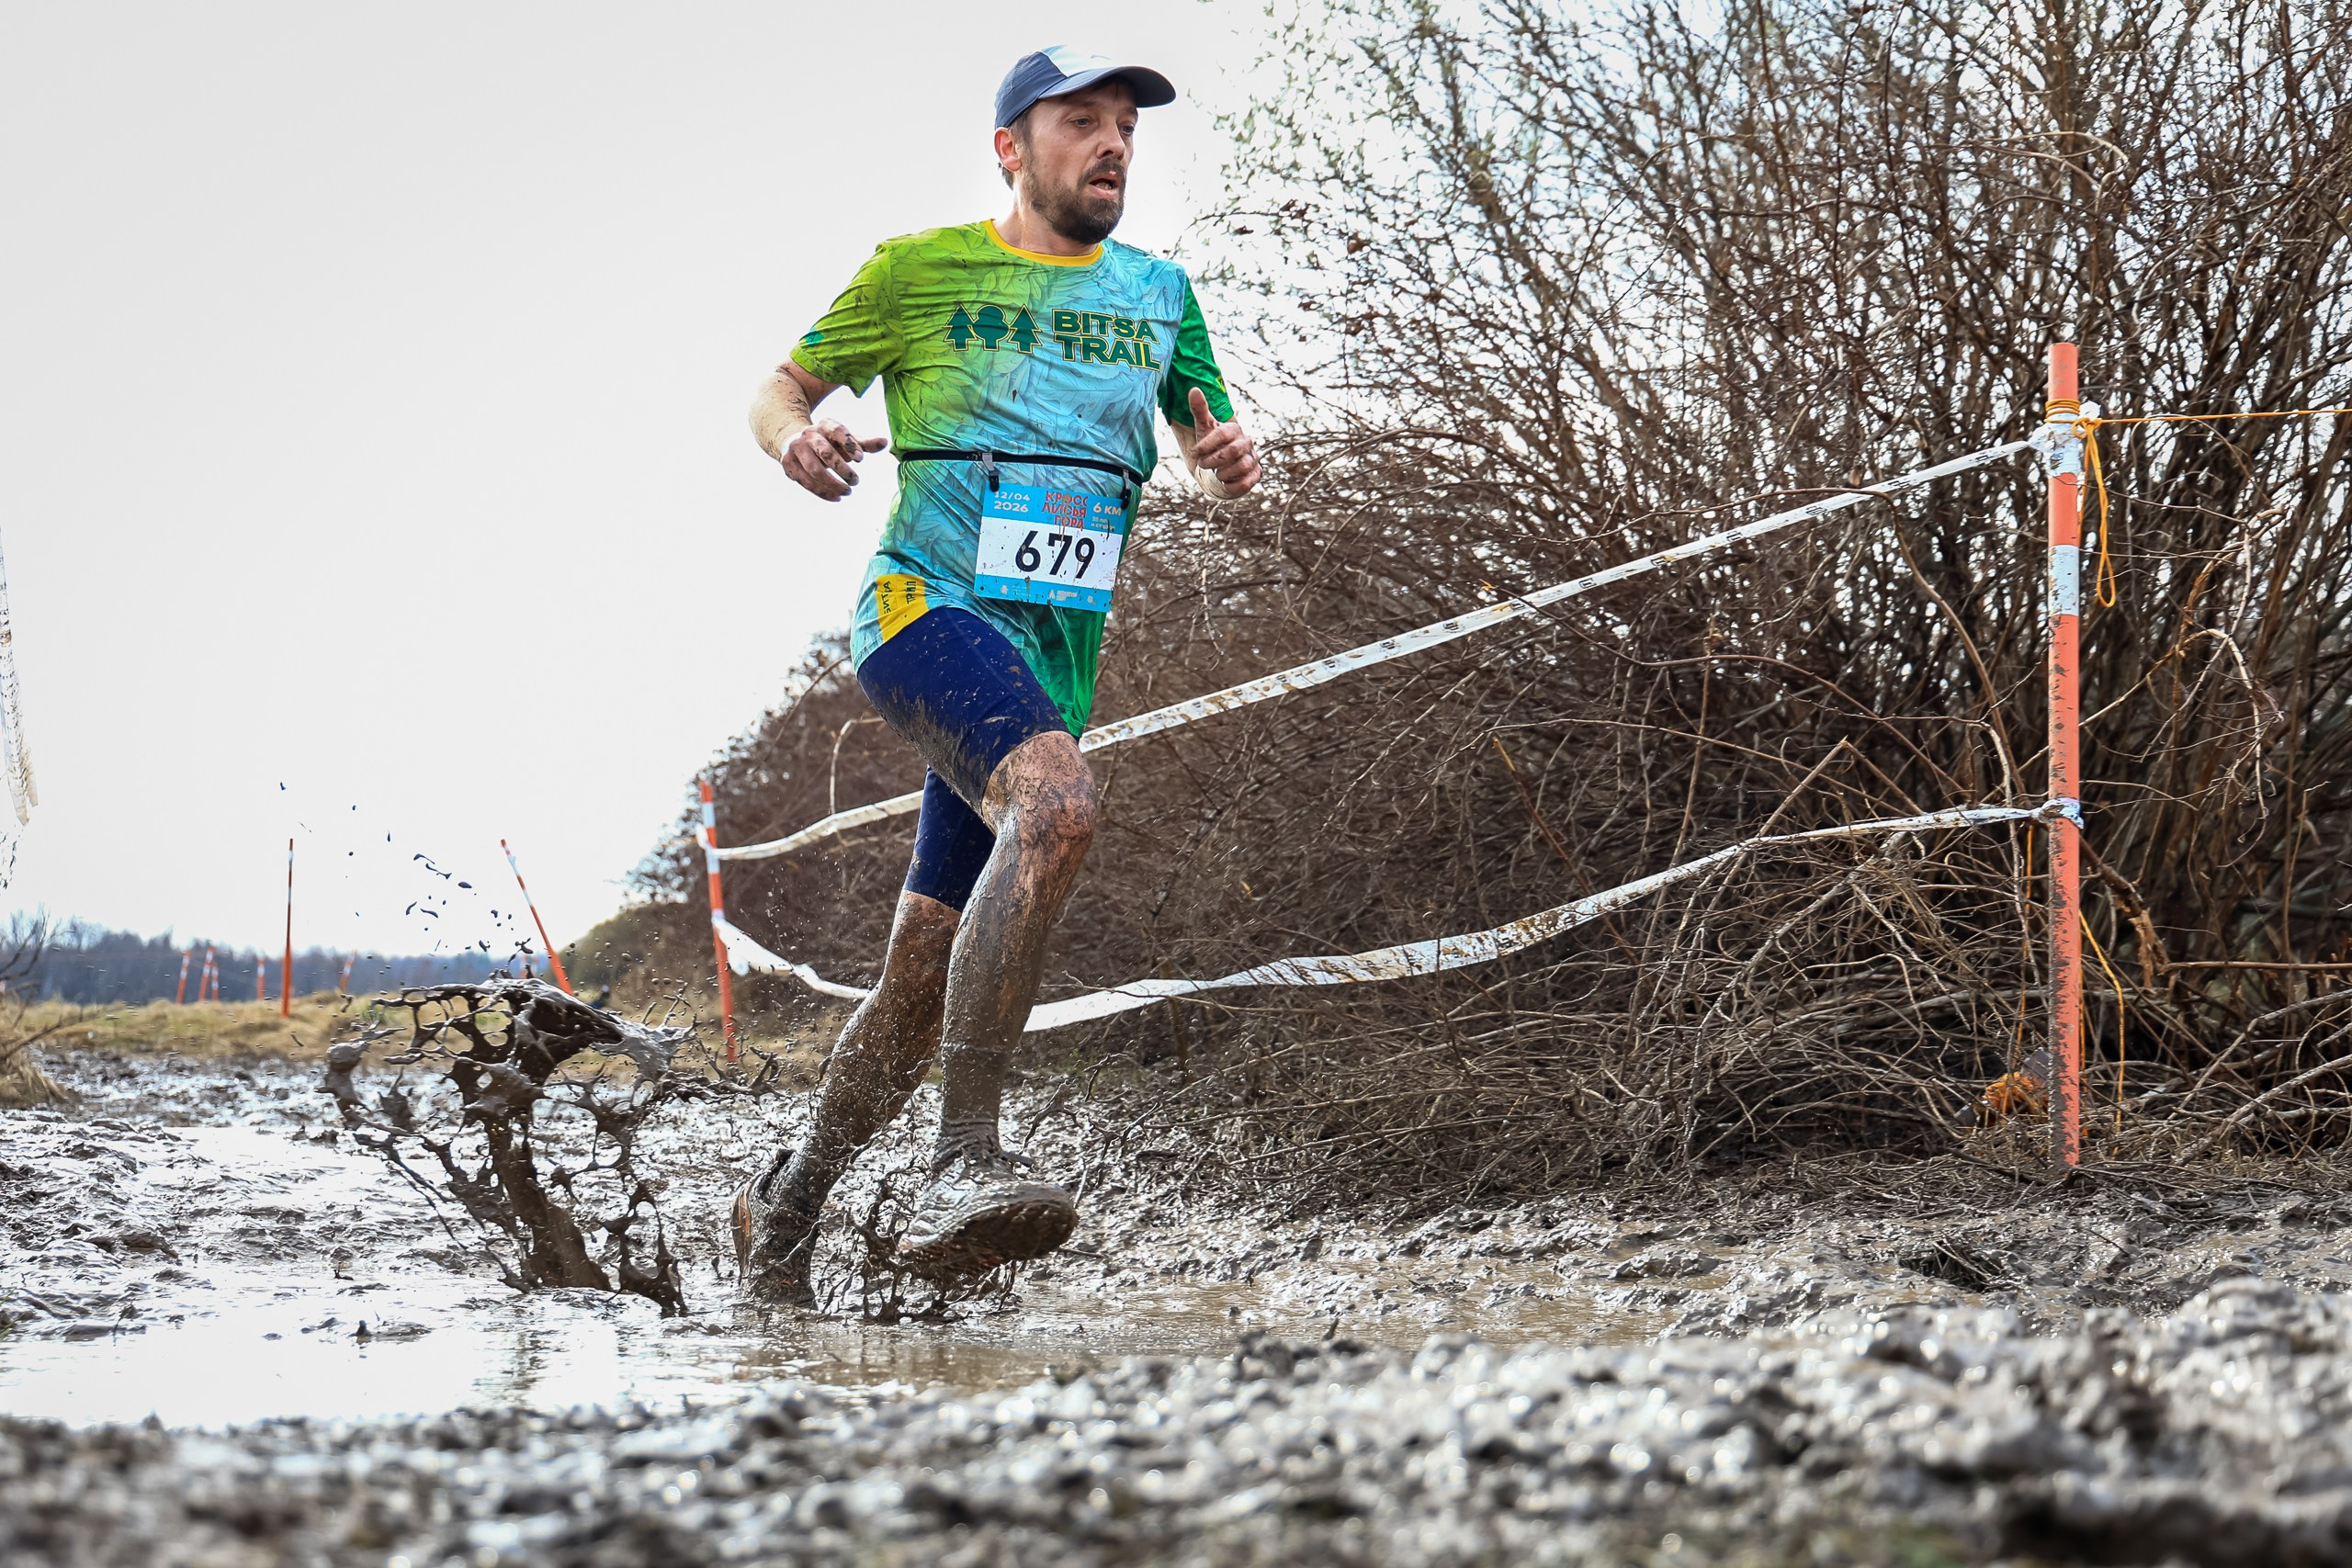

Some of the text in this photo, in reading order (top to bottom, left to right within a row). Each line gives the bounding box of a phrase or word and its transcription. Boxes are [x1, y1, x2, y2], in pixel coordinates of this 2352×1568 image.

[1052, 309, 1160, 344] BITSA
[1054, 333, 1161, 372] TRAIL
[994, 491, 1030, 502] 12/04
[994, 501, 1029, 513] 2026
[1041, 502, 1087, 518] ЛИСЬЯ
[1093, 502, 1102, 513] 6
[1015, 530, 1095, 580] 679
